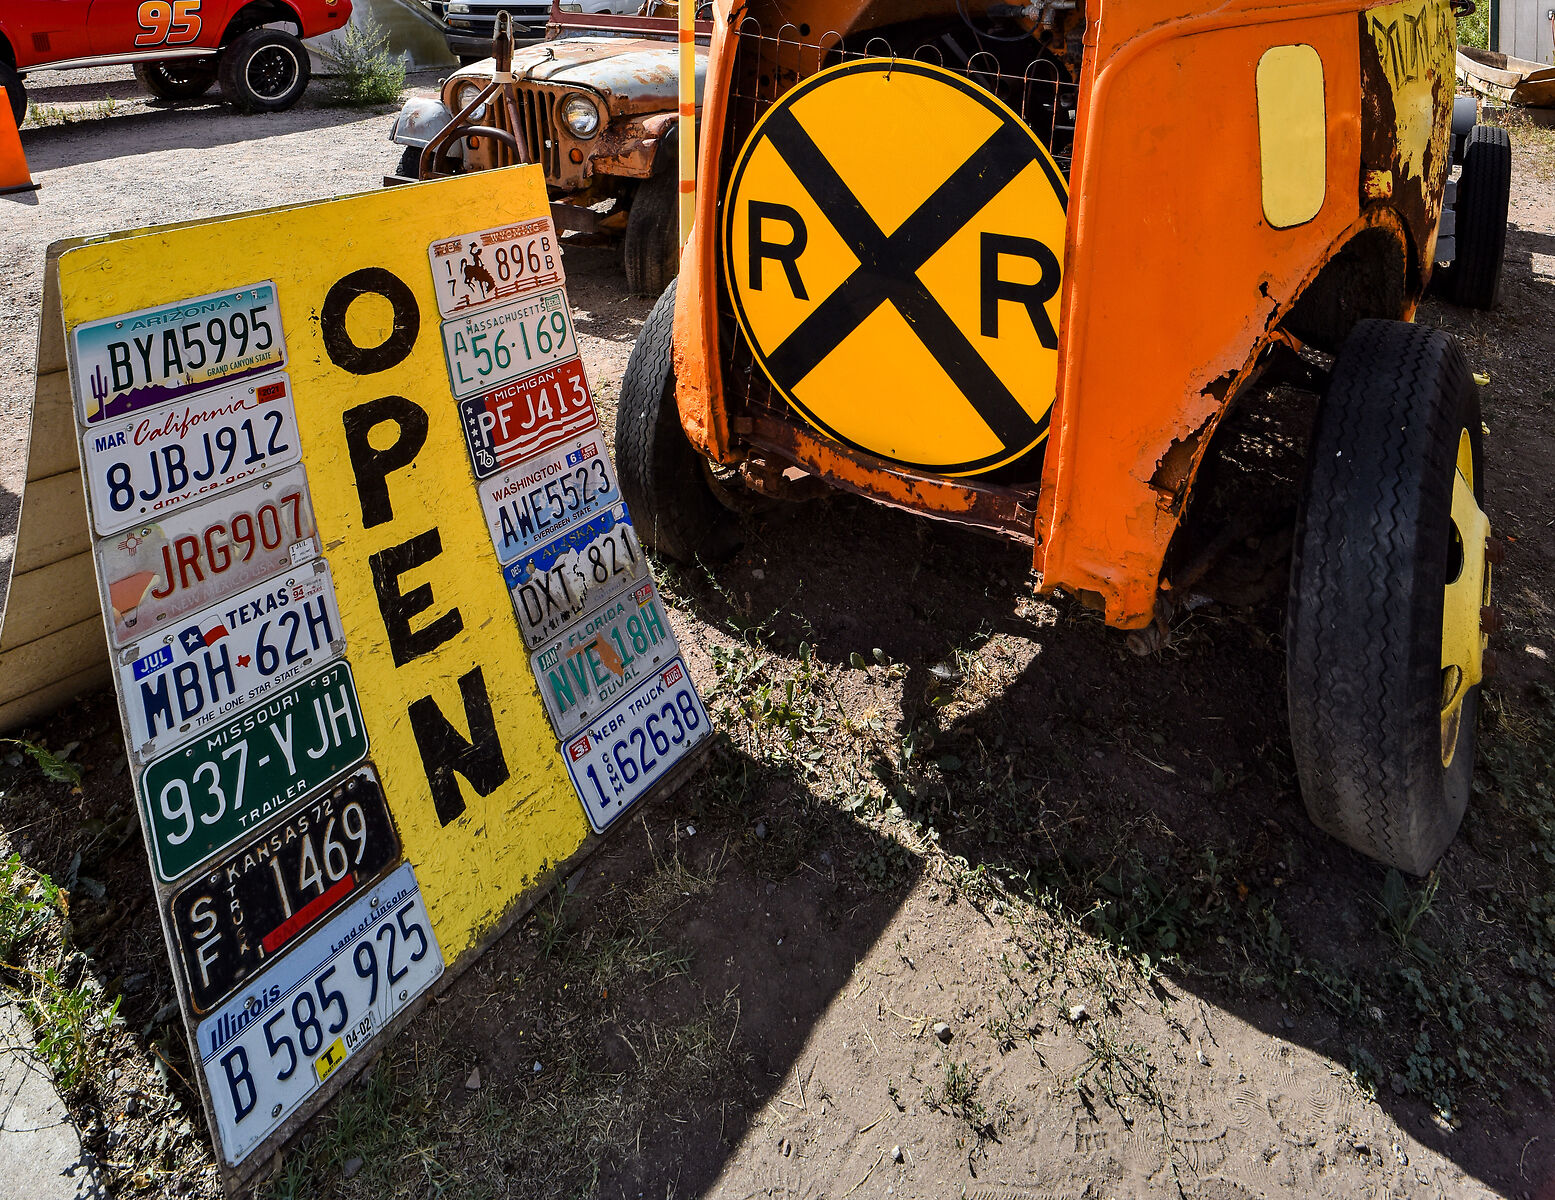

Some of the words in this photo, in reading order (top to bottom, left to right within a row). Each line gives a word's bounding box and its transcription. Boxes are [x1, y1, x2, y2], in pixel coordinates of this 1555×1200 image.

[134, 0, 202, 48] 95
[490, 223, 541, 242] WYOMING
[495, 240, 541, 282] 896
[748, 200, 810, 301] R
[980, 232, 1062, 350] R
[131, 300, 231, 331] ARIZONA
[466, 299, 546, 335] MASSACHUSETTS
[107, 306, 273, 393] BYA5995
[207, 364, 229, 377] GRAND
[230, 357, 254, 372] CANYON
[255, 351, 272, 365] STATE
[262, 385, 279, 397] 2021
[495, 372, 555, 402] MICHIGAN
[95, 431, 127, 453] MAR
[134, 396, 258, 446] California
[106, 410, 289, 512] 8JBJ912
[476, 449, 495, 468] 76
[570, 453, 578, 463] 6
[153, 467, 257, 511] dmv.ca.gov
[492, 461, 563, 502] WASHINGTON
[499, 459, 611, 548] AWE5523
[151, 491, 302, 600] JRG907
[533, 517, 571, 542] EVERGREEN
[572, 505, 592, 521] STATE
[542, 524, 595, 560] ALASKA
[321, 266, 511, 829] OPEN
[171, 593, 198, 613] NEW
[250, 560, 276, 580] USA
[293, 588, 305, 598] 94
[510, 564, 522, 578] DEC
[518, 563, 571, 628] DXT
[588, 528, 636, 583] 821
[226, 587, 289, 629] TEXAS
[568, 601, 625, 647] FLORIDA
[140, 651, 168, 672] JUL
[140, 644, 236, 739] MBH
[255, 595, 334, 676] 62H
[541, 653, 558, 670] JAN
[195, 711, 215, 727] THE
[219, 697, 244, 715] LONE
[248, 681, 271, 699] STAR
[274, 666, 300, 685] STATE
[599, 668, 640, 702] DUVAL
[207, 691, 300, 752] MISSOURI
[322, 671, 339, 687] 97
[592, 713, 625, 745] NEBR
[628, 681, 664, 716] TRUCK
[612, 689, 701, 785] 62638
[587, 763, 610, 809] 1
[602, 753, 625, 797] COMM
[239, 779, 307, 827] TRAILER
[226, 816, 309, 883] KANSAS
[312, 799, 333, 824] 72
[269, 802, 367, 920] 1469
[226, 888, 250, 956] TRUCK
[331, 930, 357, 953] Land
[358, 915, 370, 930] of
[370, 888, 408, 922] Lincoln
[211, 983, 281, 1050] Illinois
[346, 1017, 372, 1048] 04-02
[321, 1046, 334, 1066] T
[220, 1045, 258, 1125] B
